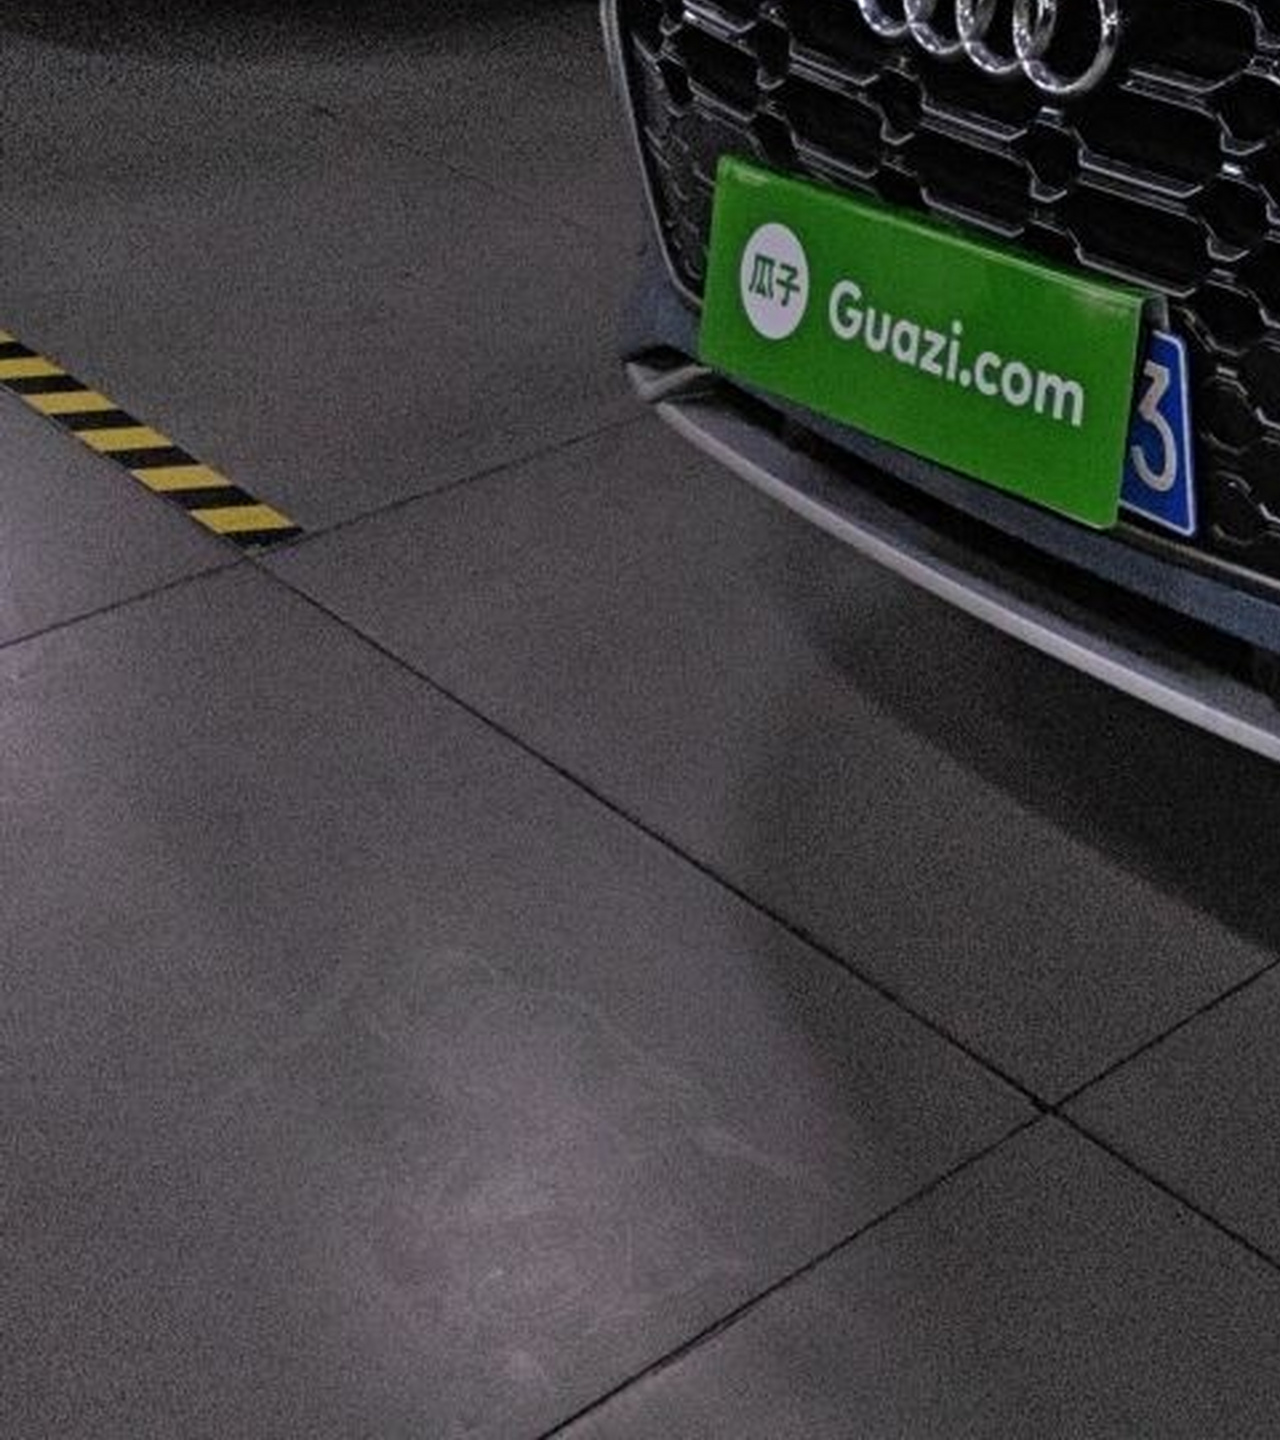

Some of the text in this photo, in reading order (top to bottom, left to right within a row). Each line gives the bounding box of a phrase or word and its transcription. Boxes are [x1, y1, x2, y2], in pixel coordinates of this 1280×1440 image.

[748, 253, 800, 308] 瓜子
[828, 279, 1083, 428] Guazi.com
[1131, 360, 1178, 492] 3
